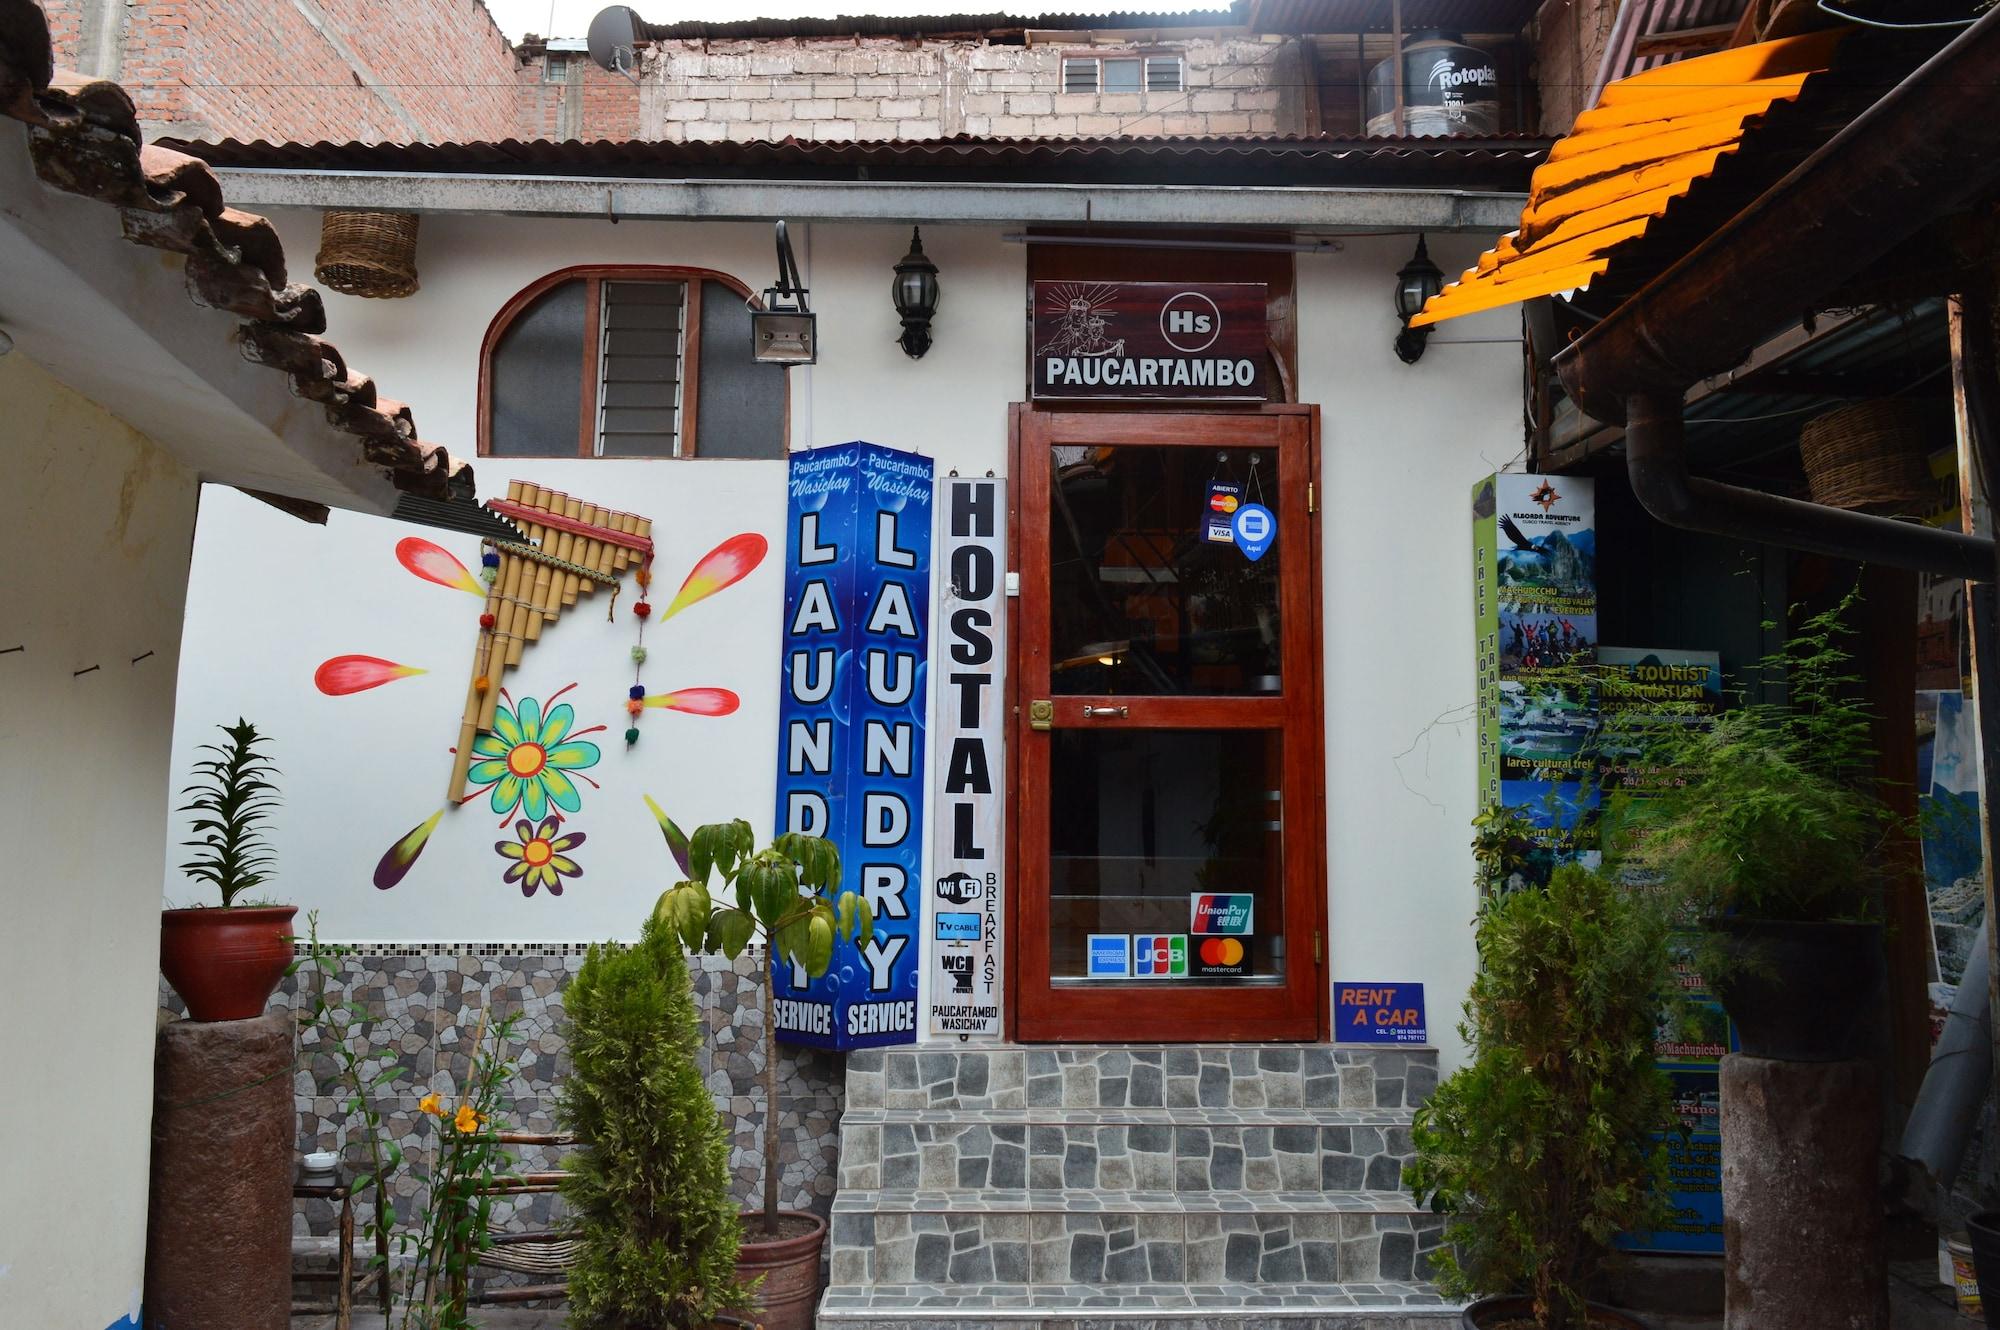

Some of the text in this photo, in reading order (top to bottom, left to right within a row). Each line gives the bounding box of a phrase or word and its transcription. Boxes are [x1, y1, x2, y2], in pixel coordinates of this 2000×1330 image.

[1439, 65, 1496, 90] Rotoplas
[1169, 311, 1211, 333] Hs
[1046, 358, 1255, 387] PAUCARTAMBO
[793, 453, 850, 476] Paucartambo
[869, 453, 930, 480] Paucartambo
[791, 474, 851, 498] Wasichay
[867, 471, 930, 505] Wasichay
[1212, 485, 1239, 493] ABIERTO
[1545, 514, 1581, 522] ADVENTURE
[1213, 529, 1231, 537] VISA
[1498, 586, 1557, 595] MACHUPICCHU
[1554, 607, 1595, 615] EVERYDAY
[1571, 598, 1595, 606] VALLEY
[945, 483, 994, 860] HOSTAL
[1637, 665, 1709, 681] TOURIST
[787, 511, 839, 990] LAUNDY
[857, 510, 919, 992] LAUNDRY
[1506, 757, 1530, 768] lares
[1532, 758, 1571, 769] cultural
[1199, 904, 1248, 920] UnionPay
[984, 872, 996, 994] BREAKFAST
[942, 956, 965, 970] WC
[1137, 950, 1184, 962] JCB
[1341, 988, 1396, 1006] RENT
[773, 998, 831, 1035] SERVICE
[847, 1001, 914, 1036] SERVICE
[932, 1006, 997, 1018] PAUCARTAMBO
[1353, 1008, 1418, 1026] A CAR
[942, 1019, 988, 1031] WASICHAY
[1667, 1043, 1726, 1058] Machupicchu
